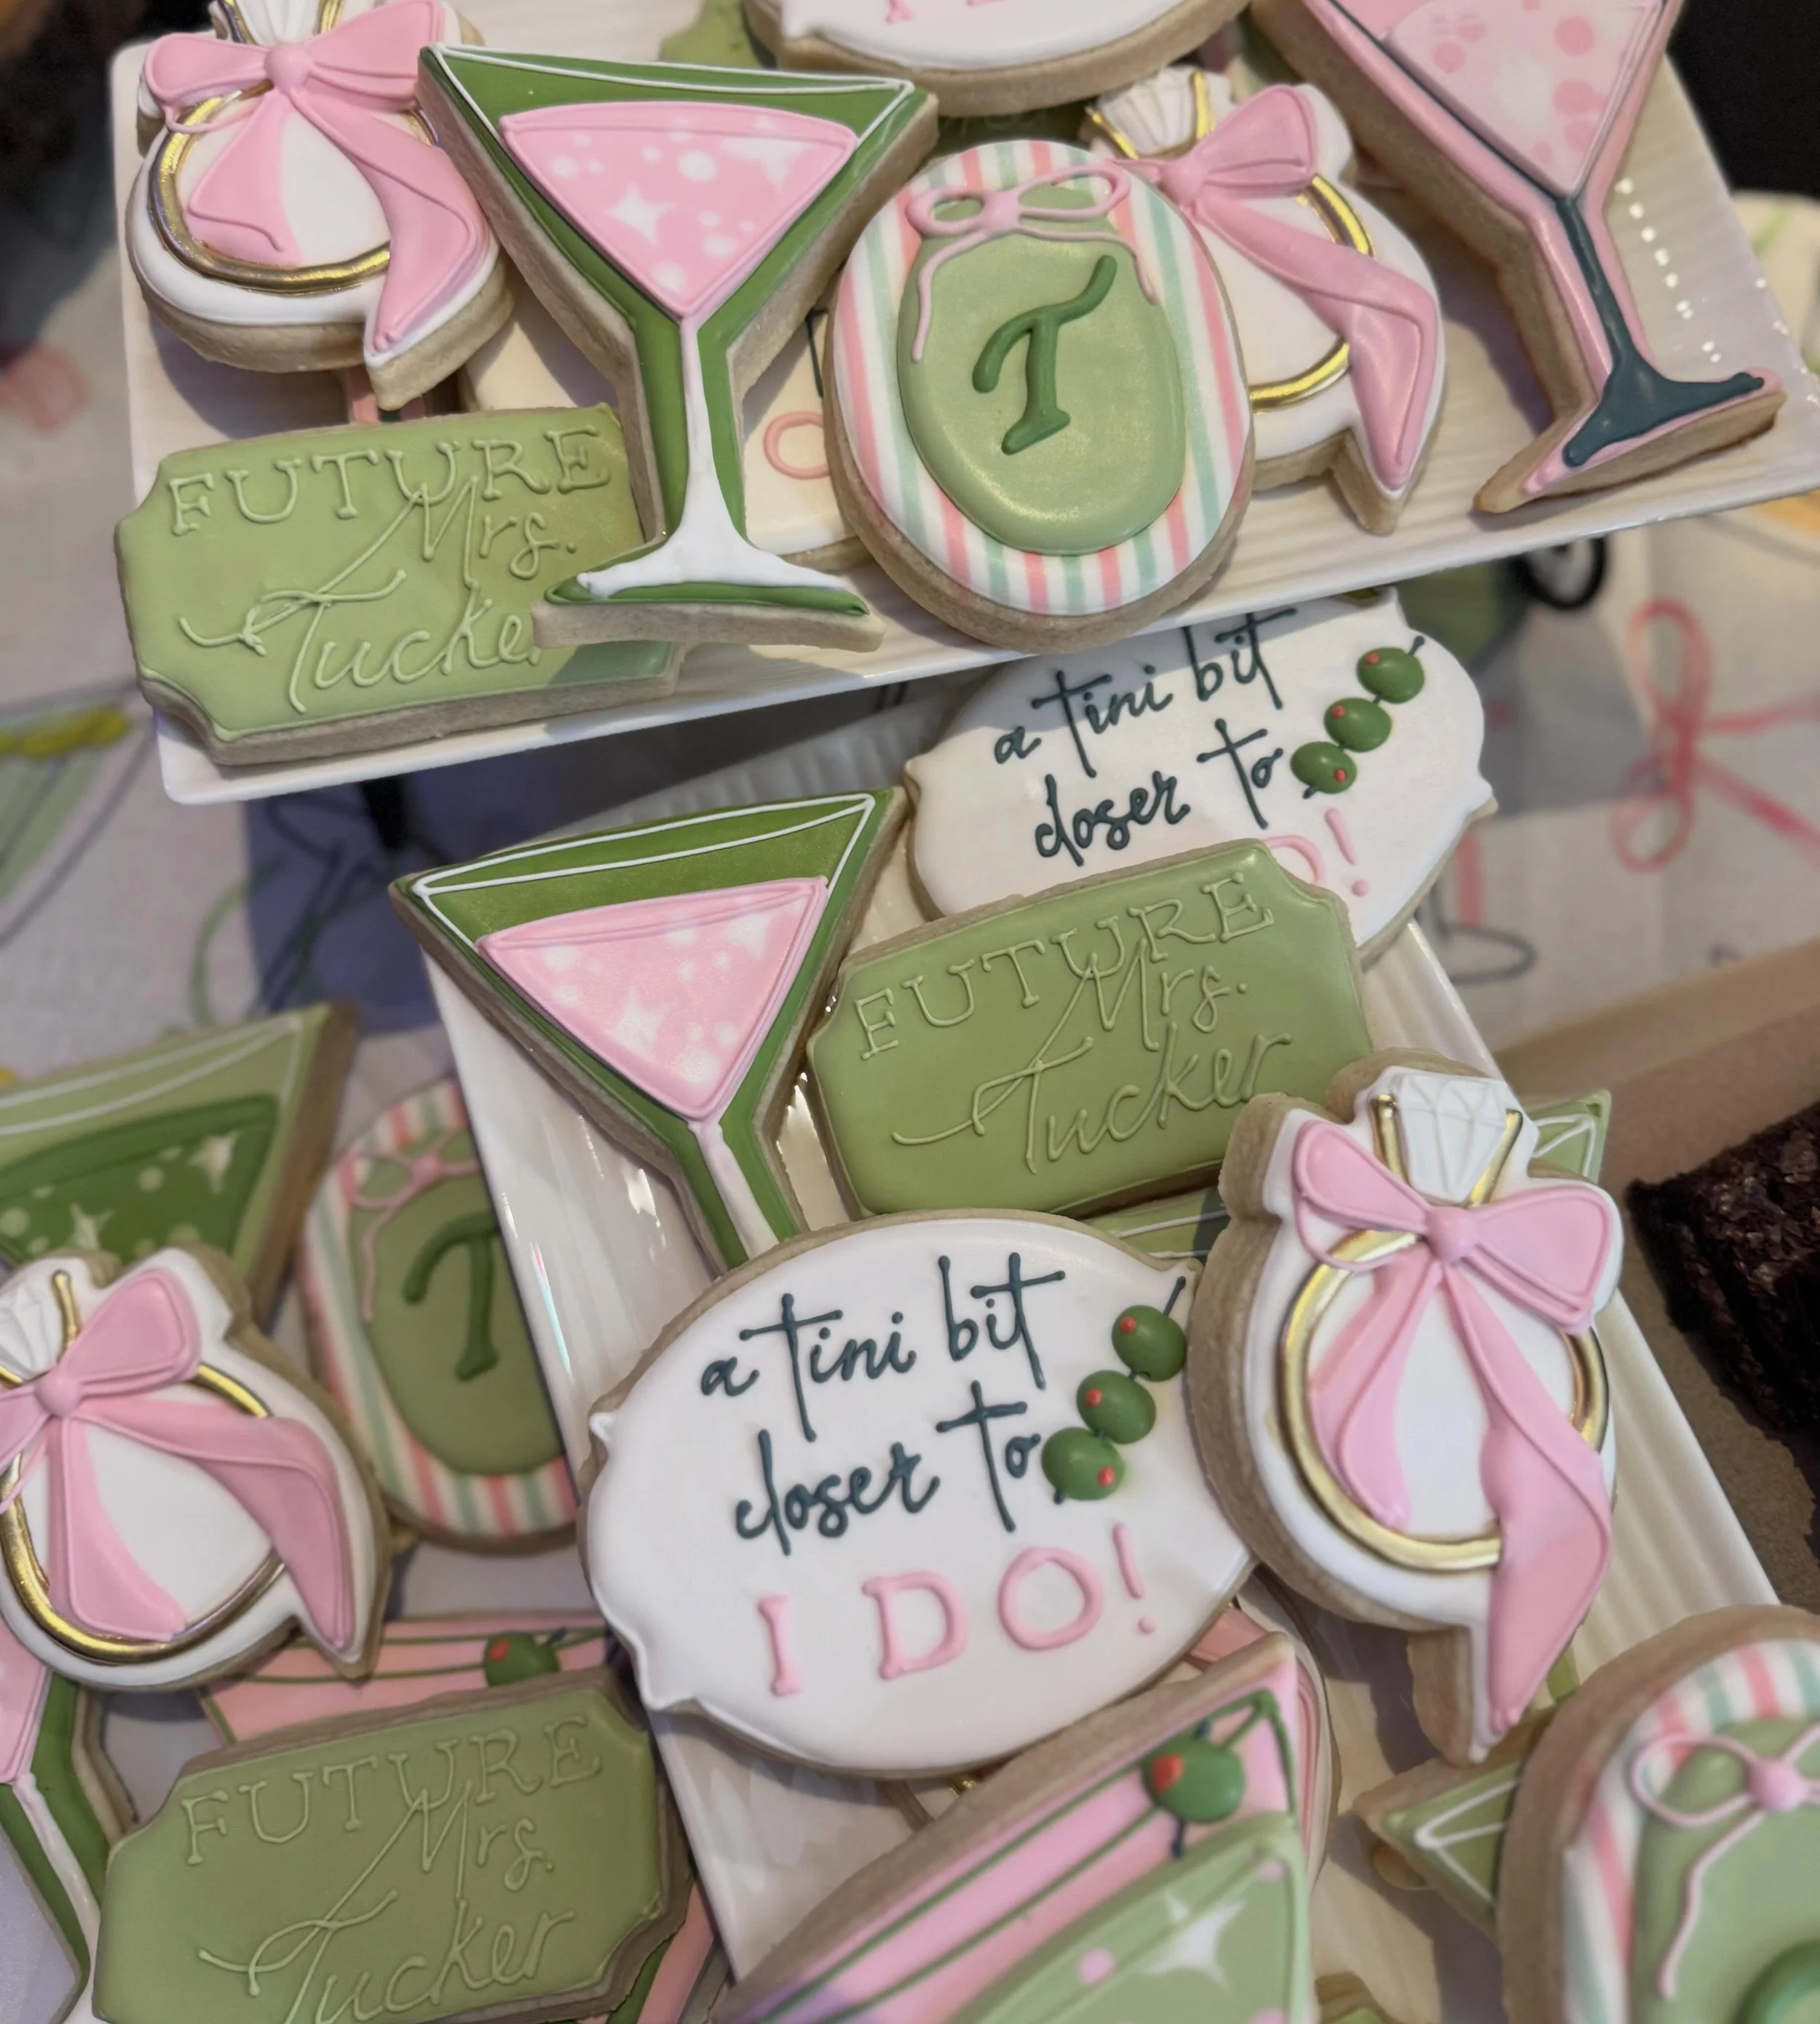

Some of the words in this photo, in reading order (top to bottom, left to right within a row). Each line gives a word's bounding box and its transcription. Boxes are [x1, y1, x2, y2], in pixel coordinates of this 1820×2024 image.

[973, 255, 1117, 456] T
[168, 425, 610, 536] FUTURE
[245, 569, 540, 713] Tucke
[994, 725, 1042, 764] a
[1031, 670, 1174, 778] tini
[1182, 609, 1297, 711] bit
[1034, 770, 1190, 867] closer
[1196, 717, 1283, 831] to
[853, 871, 1275, 1061] FUTURE
[971, 1021, 1293, 1175] Tucker
[402, 1209, 504, 1381] T
[700, 1356, 760, 1396] a
[740, 1292, 917, 1442] tini
[938, 1252, 1066, 1390] bit
[735, 1428, 941, 1556] closer
[935, 1380, 1042, 1533] to
[756, 1594, 802, 1697] I
[861, 1522, 1156, 1680] DO!
[180, 1715, 602, 1867] FUTURE
[248, 1891, 575, 2024] Tucker
